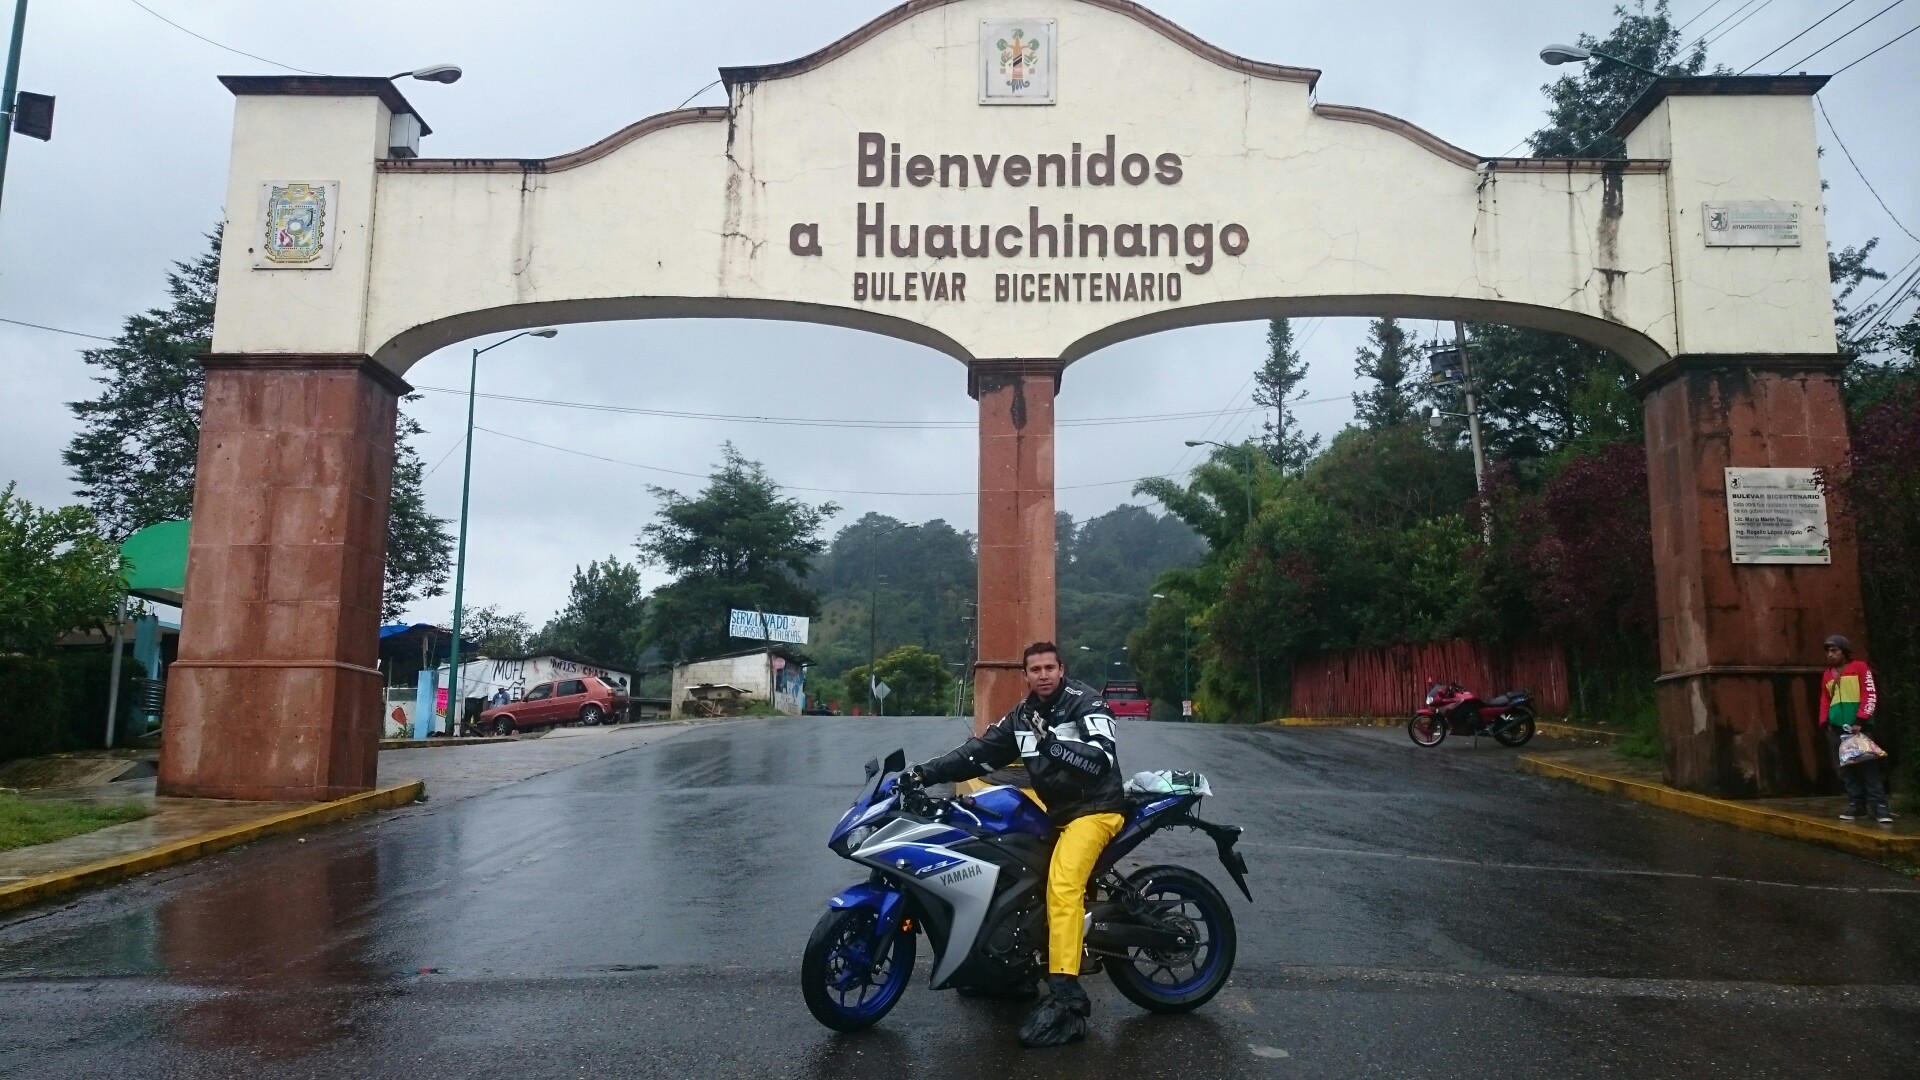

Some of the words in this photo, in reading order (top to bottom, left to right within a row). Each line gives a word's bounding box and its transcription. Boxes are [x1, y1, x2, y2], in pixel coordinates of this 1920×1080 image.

[857, 131, 1183, 187] Bienvenidos
[789, 222, 822, 256] a
[857, 202, 1249, 275] Huauchinango
[854, 272, 966, 301] BULEVAR
[995, 273, 1182, 302] BICENTENARIO
[1061, 748, 1100, 776] YAMAHA
[940, 864, 983, 886] YAMAHA
